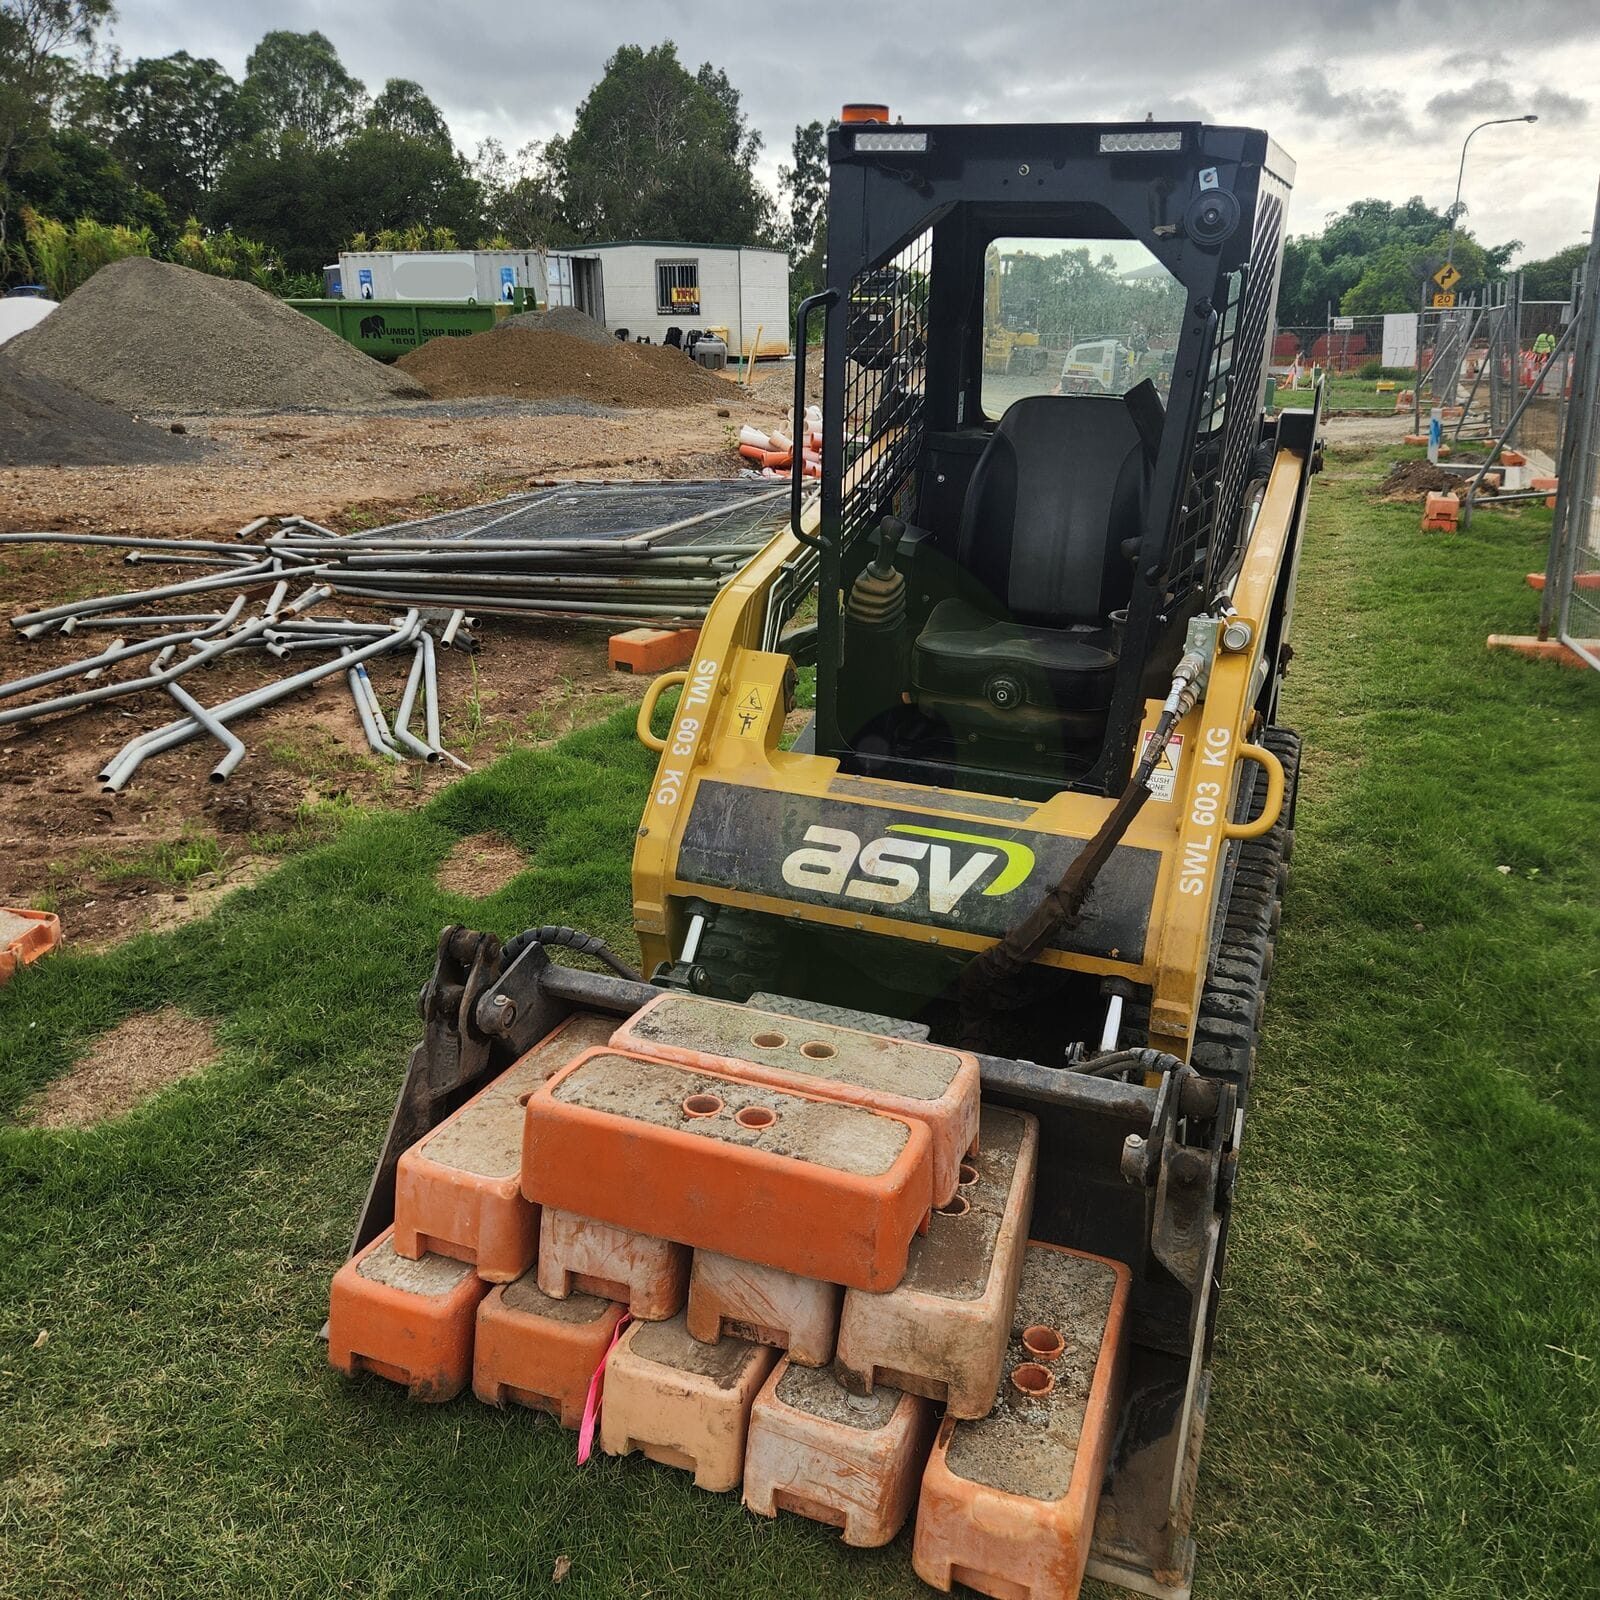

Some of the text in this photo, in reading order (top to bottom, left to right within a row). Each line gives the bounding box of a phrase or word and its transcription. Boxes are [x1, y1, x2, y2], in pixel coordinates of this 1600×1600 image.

[1437, 295, 1451, 304] 20
[422, 328, 445, 337] SKIP
[447, 328, 473, 337] BINS
[1386, 346, 1411, 366] 77
[656, 658, 717, 806] SWL 603 KG
[1150, 776, 1170, 785] RUSH
[1179, 727, 1231, 897] SWL 603 KG
